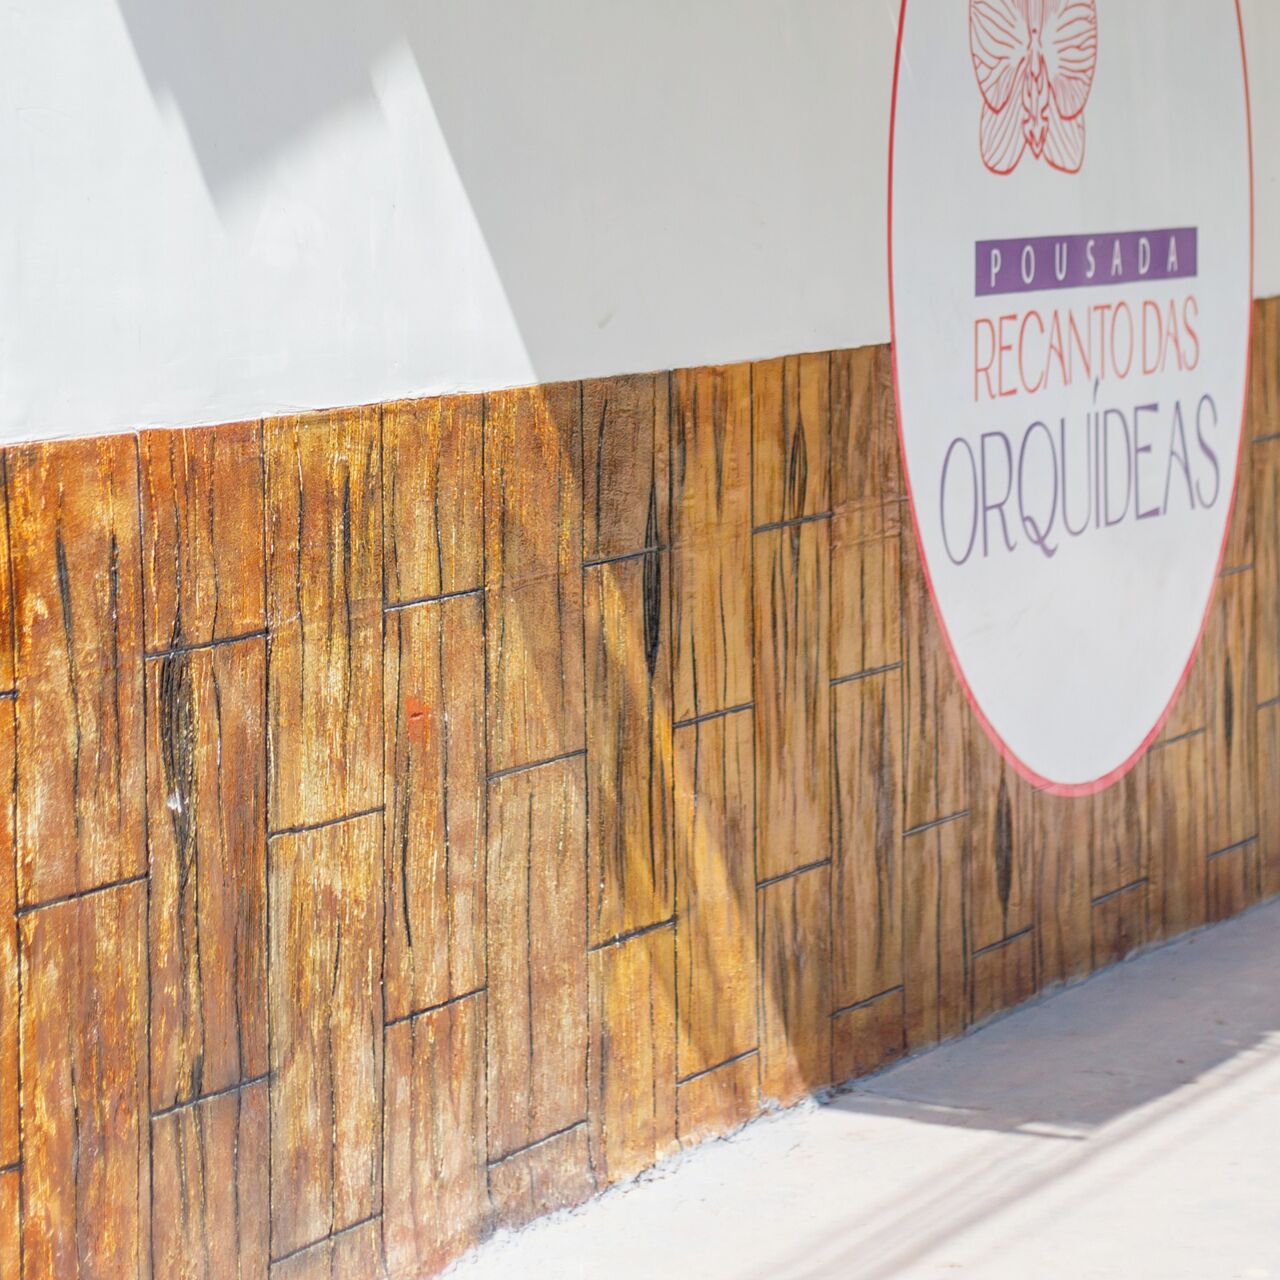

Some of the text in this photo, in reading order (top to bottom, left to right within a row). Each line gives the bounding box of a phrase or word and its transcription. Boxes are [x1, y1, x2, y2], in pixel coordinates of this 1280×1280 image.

[990, 235, 1179, 288] POUSADA
[974, 294, 1200, 401] RECANTO DAS
[939, 376, 1220, 566] ORQUÍDEAS
